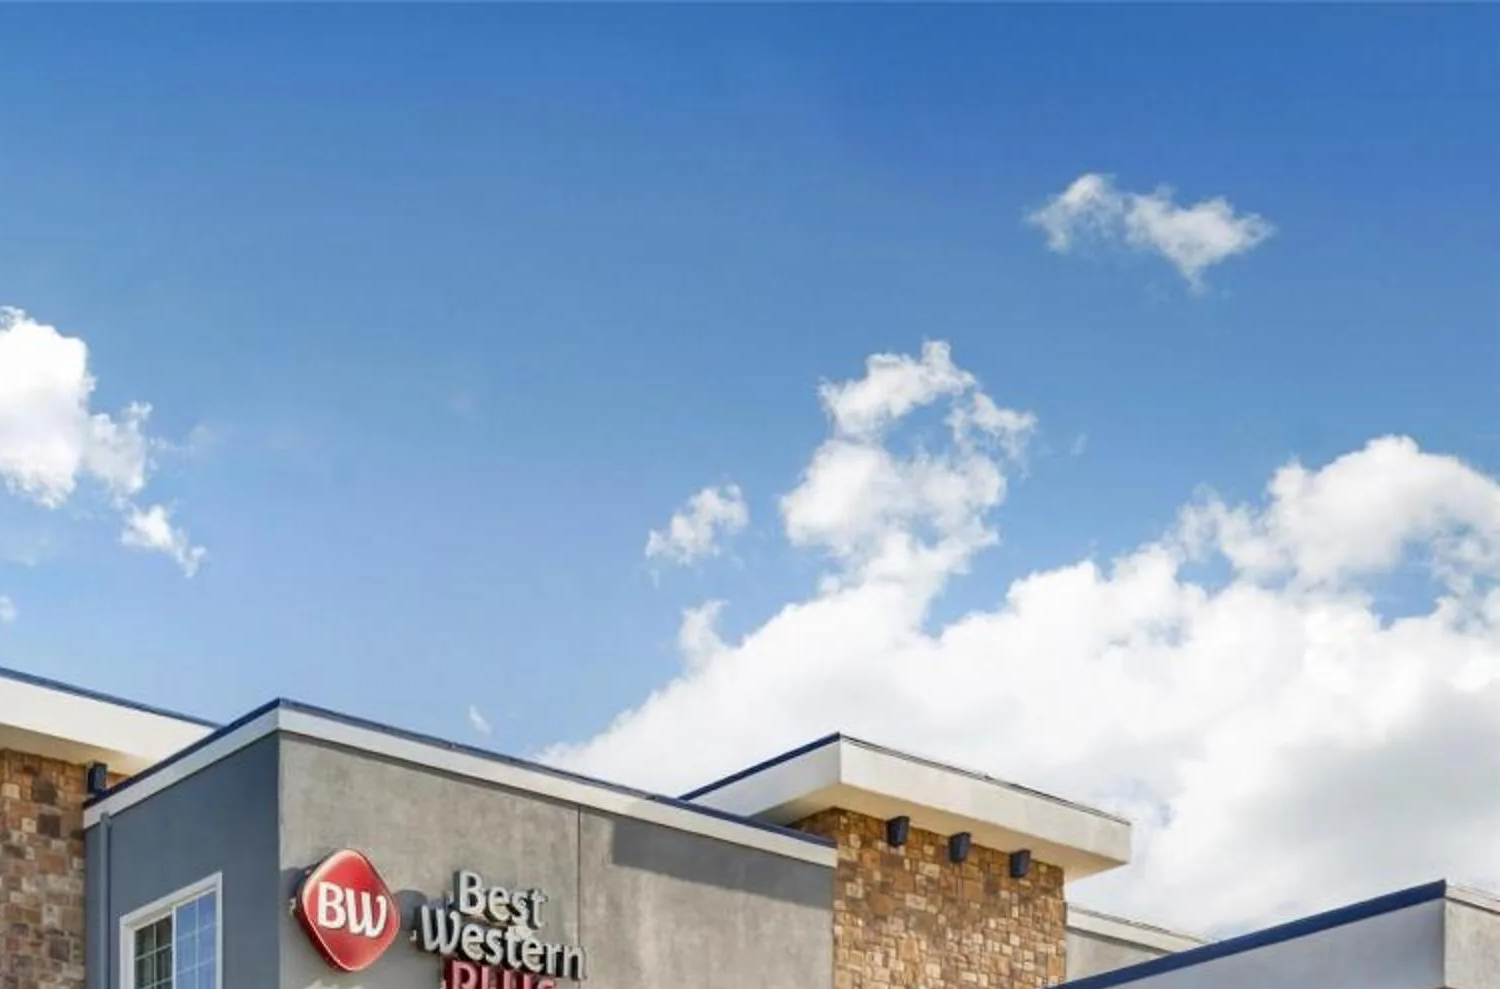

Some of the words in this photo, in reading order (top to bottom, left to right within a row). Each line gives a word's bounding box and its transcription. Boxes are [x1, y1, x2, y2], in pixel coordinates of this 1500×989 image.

[317, 882, 387, 937] BW
[457, 869, 548, 929] Best
[420, 904, 587, 980] Western
